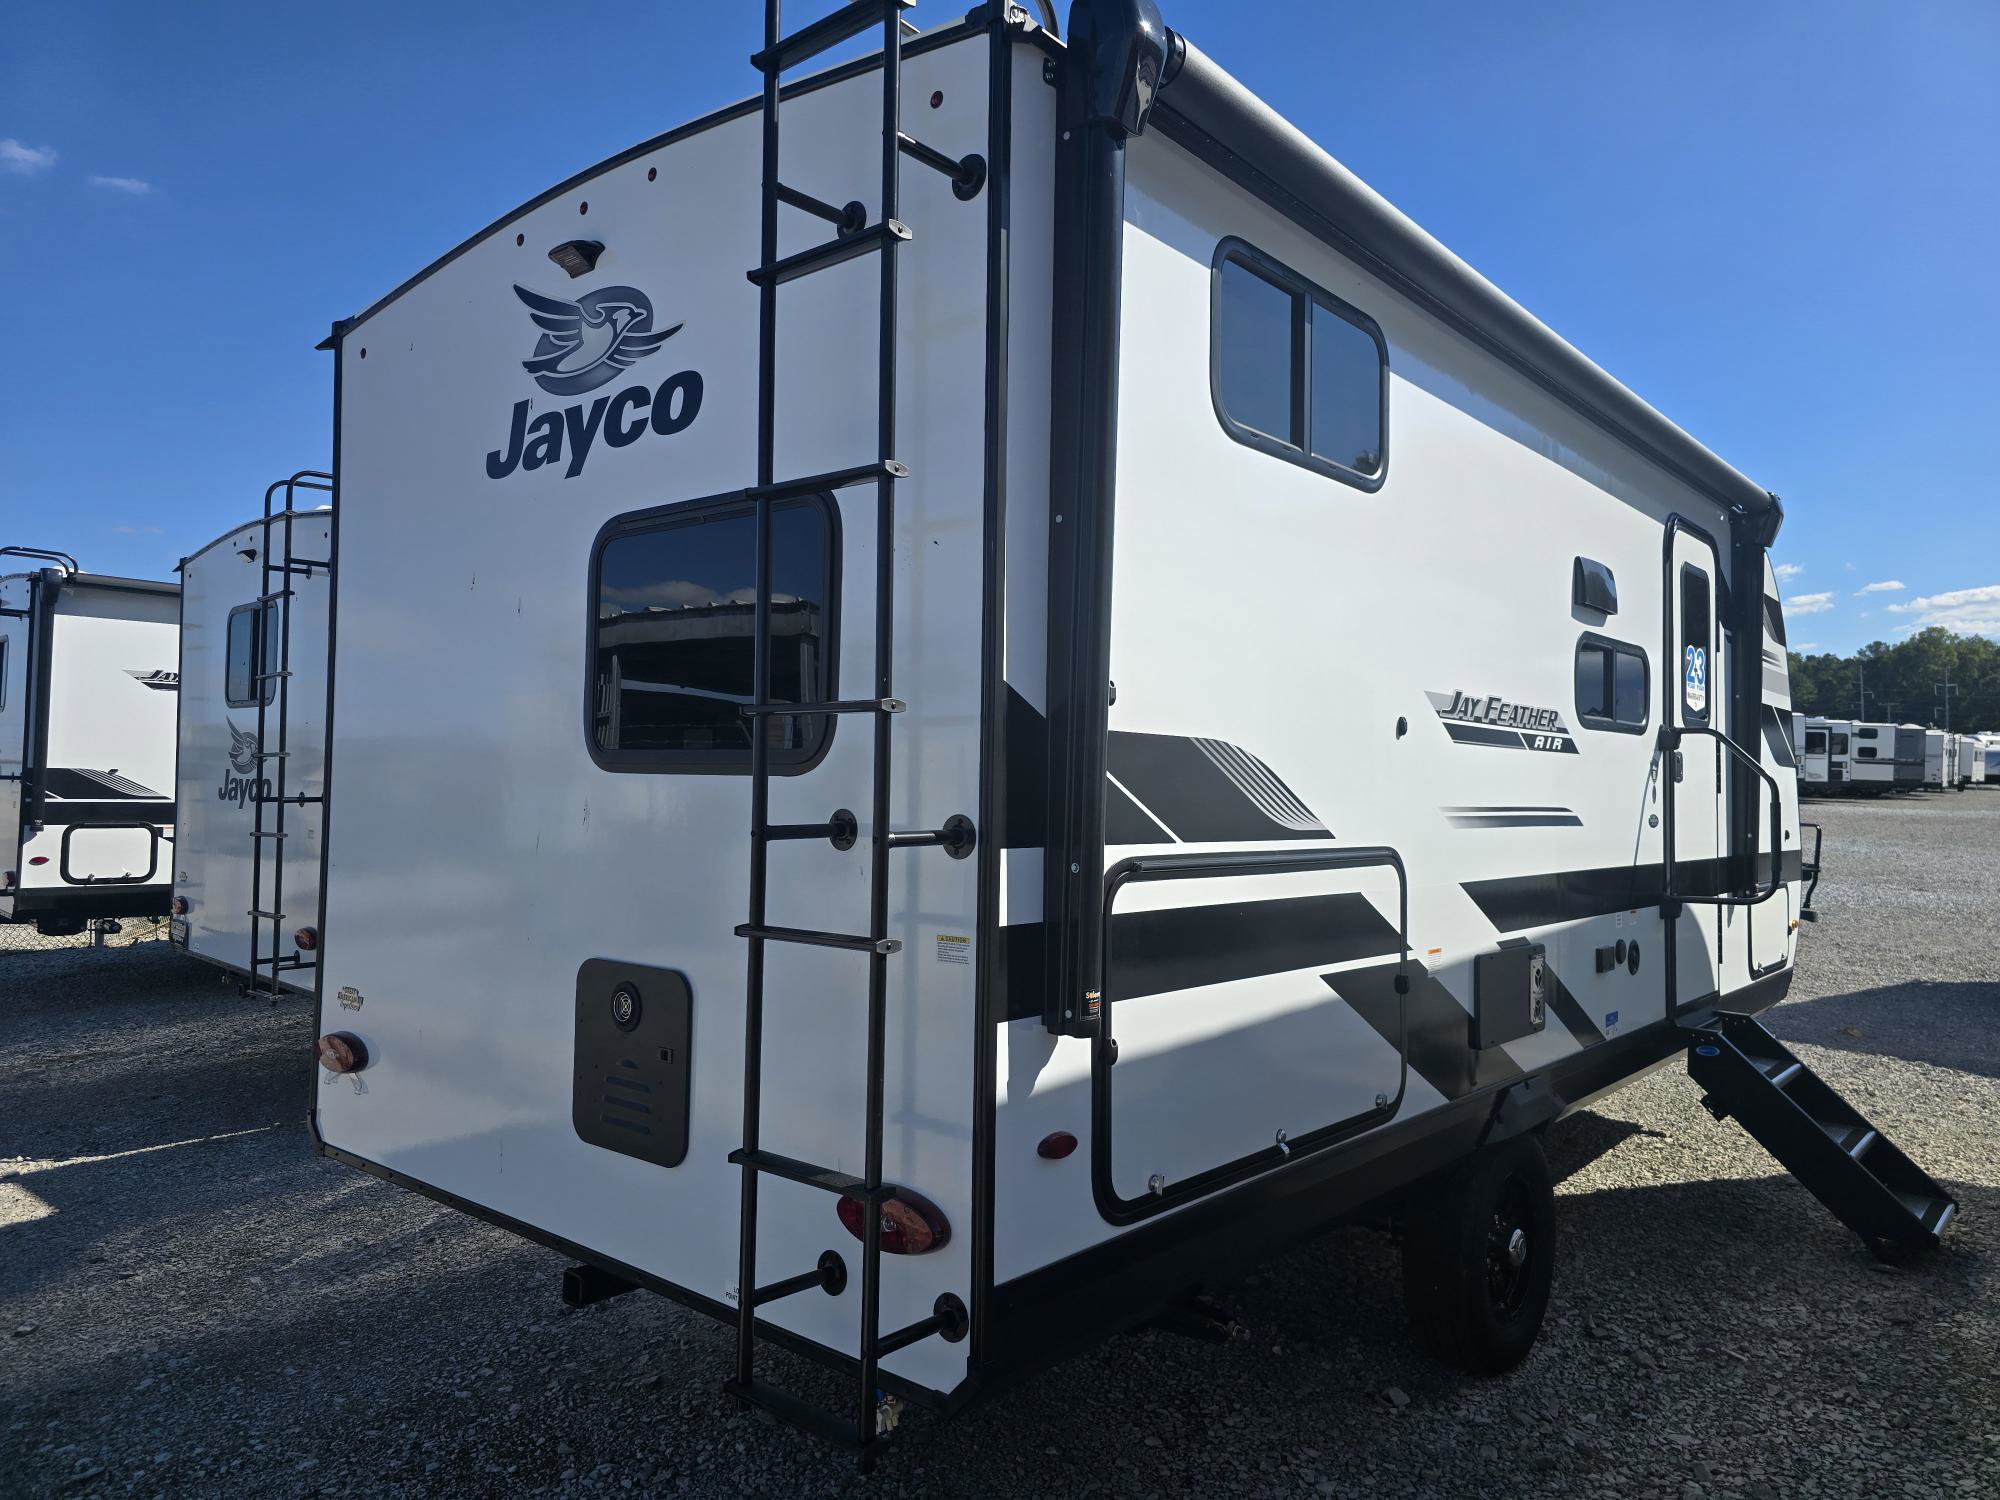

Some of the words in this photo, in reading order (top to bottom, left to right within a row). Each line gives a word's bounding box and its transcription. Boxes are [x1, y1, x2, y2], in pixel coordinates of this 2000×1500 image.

[486, 370, 704, 479] Jayco
[1440, 689, 1482, 720] JAY
[1483, 694, 1559, 731] FEATHER
[1534, 736, 1563, 750] AIR
